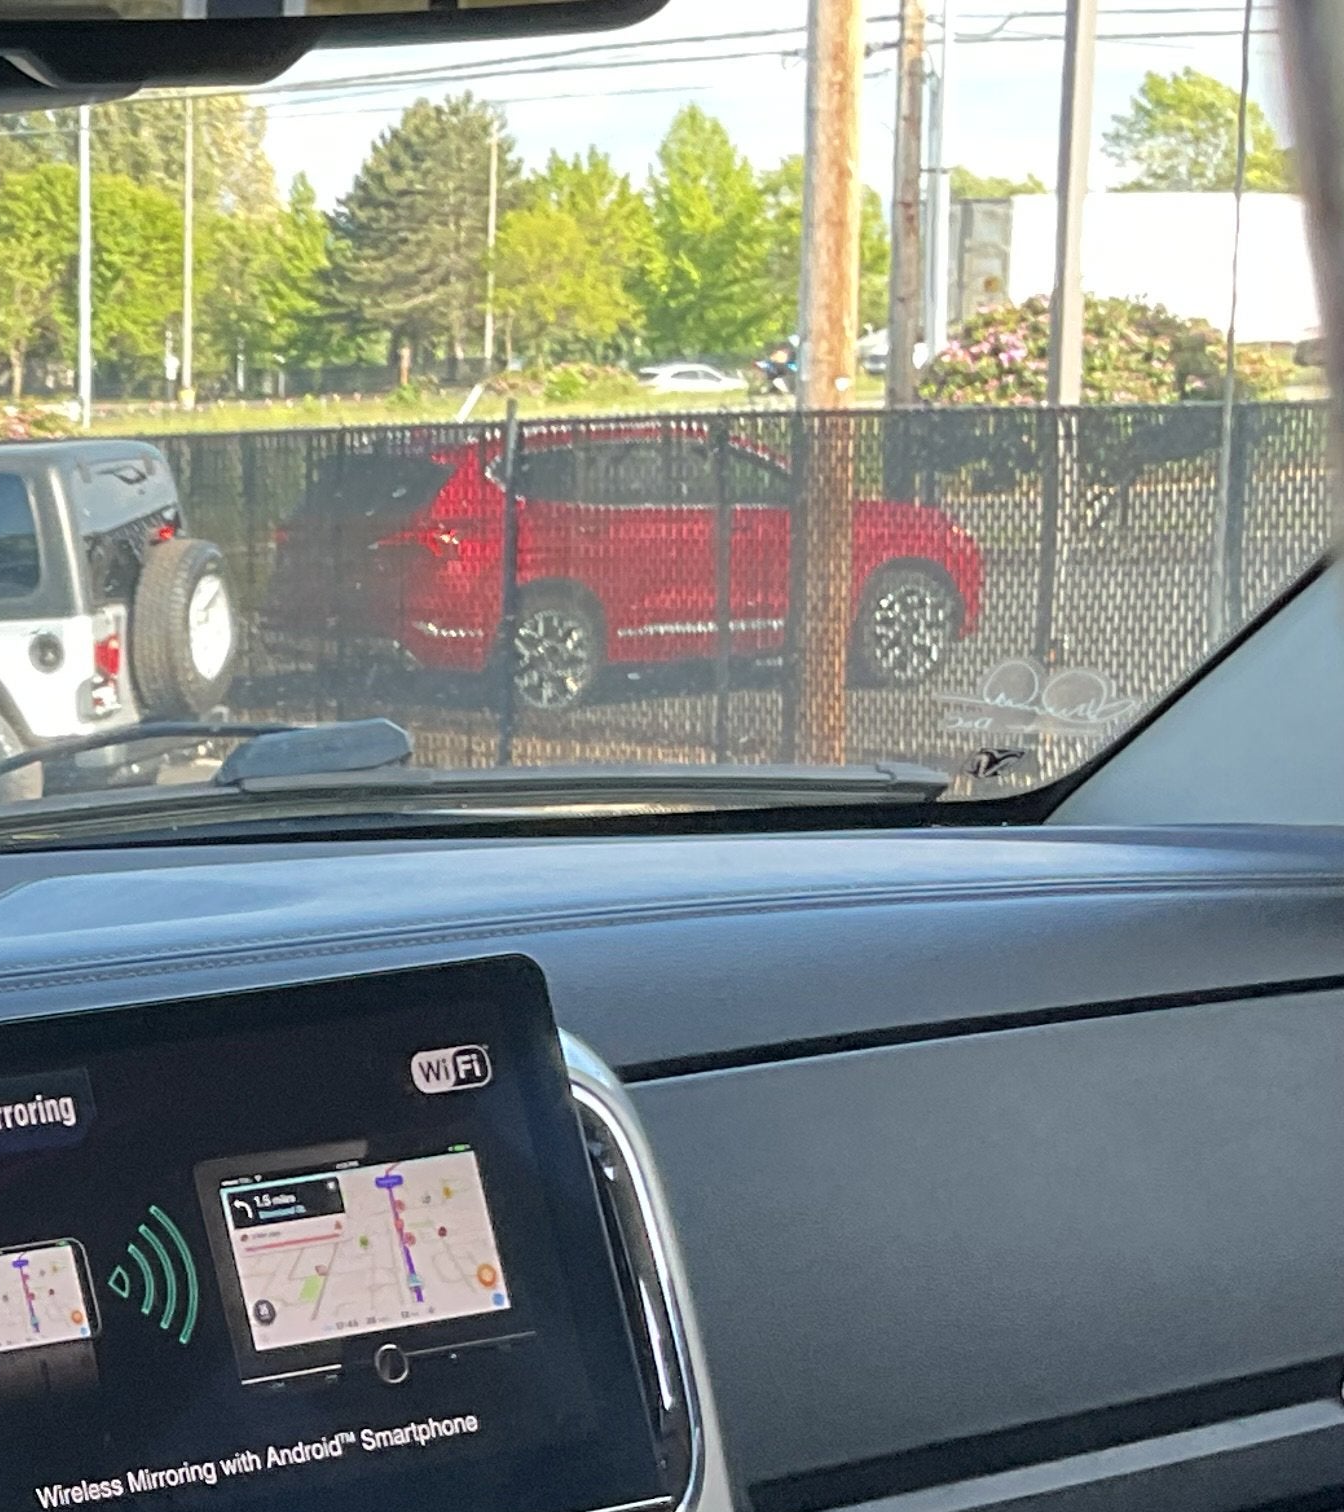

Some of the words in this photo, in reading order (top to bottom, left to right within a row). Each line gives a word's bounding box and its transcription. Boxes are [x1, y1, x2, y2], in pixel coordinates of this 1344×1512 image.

[35, 1476, 124, 1510] Wireless
[126, 1460, 217, 1495] Mirroring
[220, 1450, 263, 1476] with
[360, 1413, 479, 1452] Smartphone
